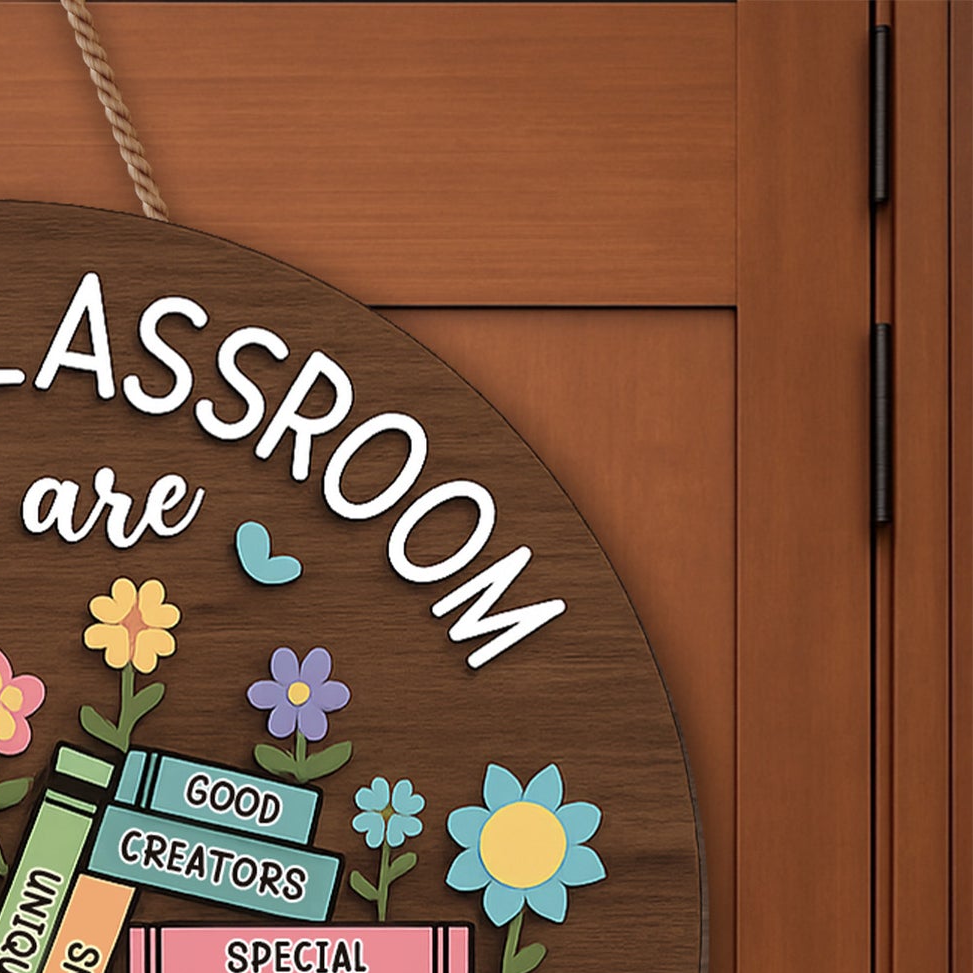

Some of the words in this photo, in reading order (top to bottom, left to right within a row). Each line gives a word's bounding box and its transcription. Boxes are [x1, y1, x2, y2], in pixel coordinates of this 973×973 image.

[23, 467, 205, 548] are
[185, 774, 281, 825] GOOD
[119, 829, 307, 902] CREATORS
